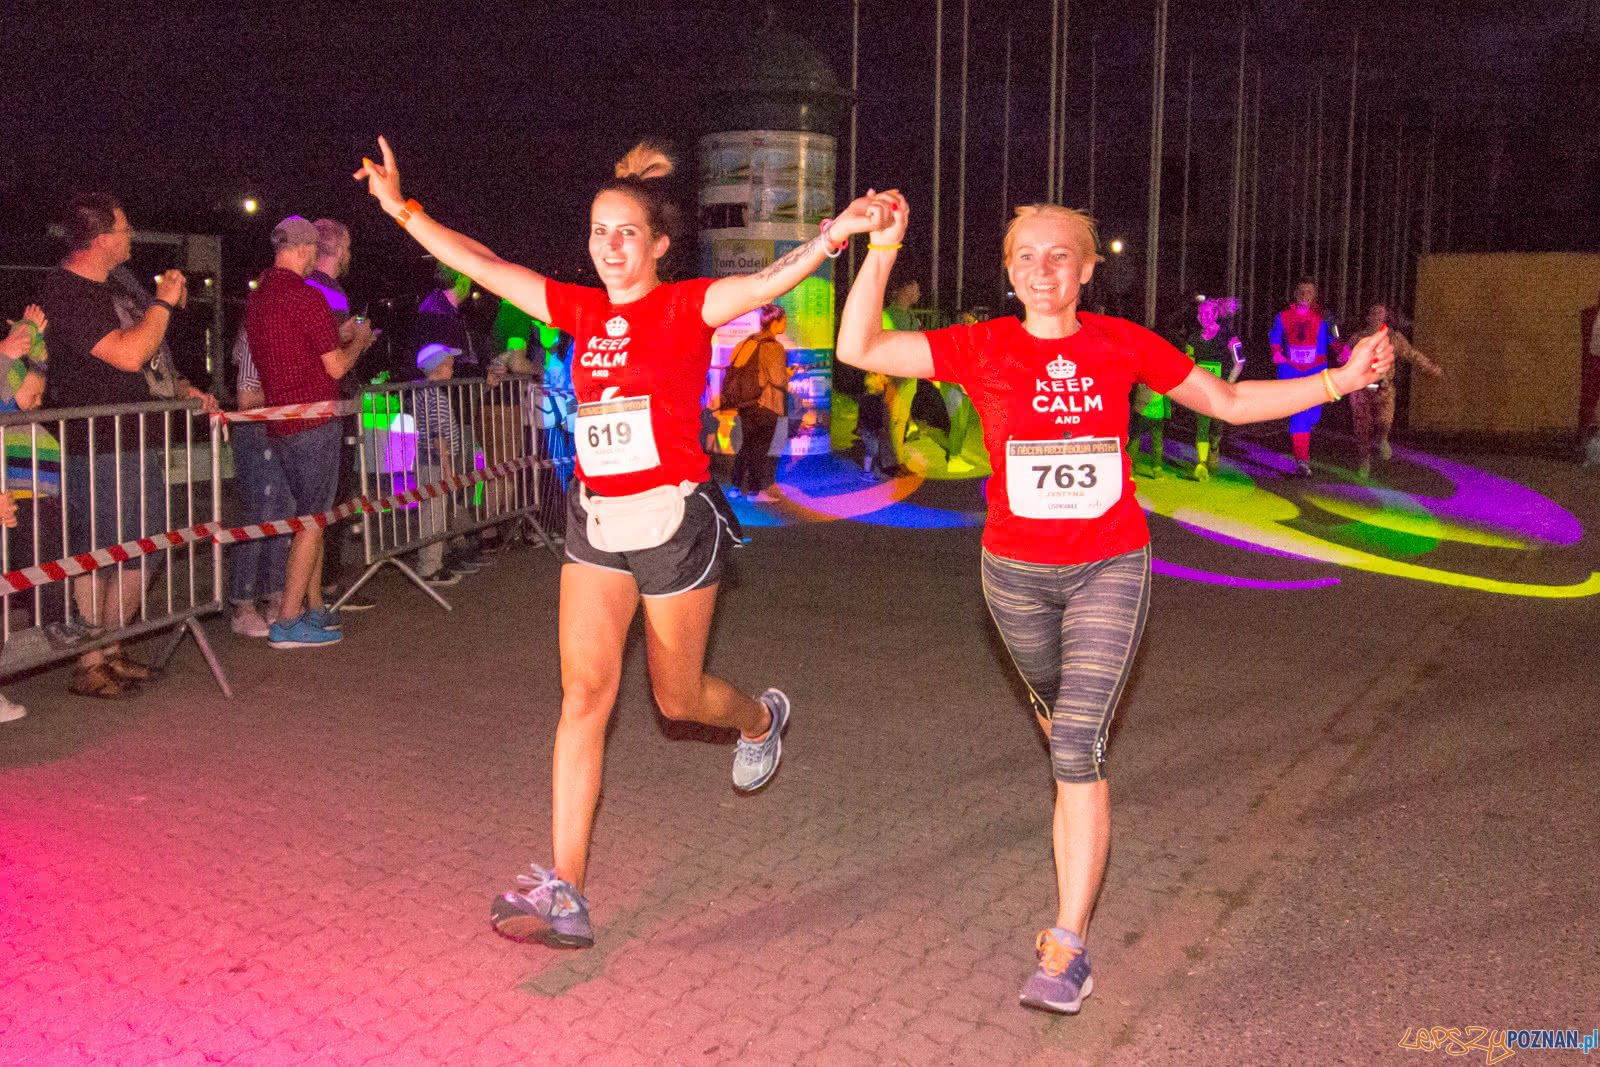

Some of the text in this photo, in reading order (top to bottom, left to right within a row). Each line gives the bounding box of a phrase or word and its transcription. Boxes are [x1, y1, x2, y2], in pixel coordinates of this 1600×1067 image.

[588, 336, 631, 350] KEEP
[581, 352, 628, 367] CALM
[1036, 377, 1094, 392] KEEP
[1032, 395, 1103, 413] CALM
[1055, 416, 1080, 424] AND
[588, 421, 632, 447] 619
[1031, 464, 1098, 489] 763
